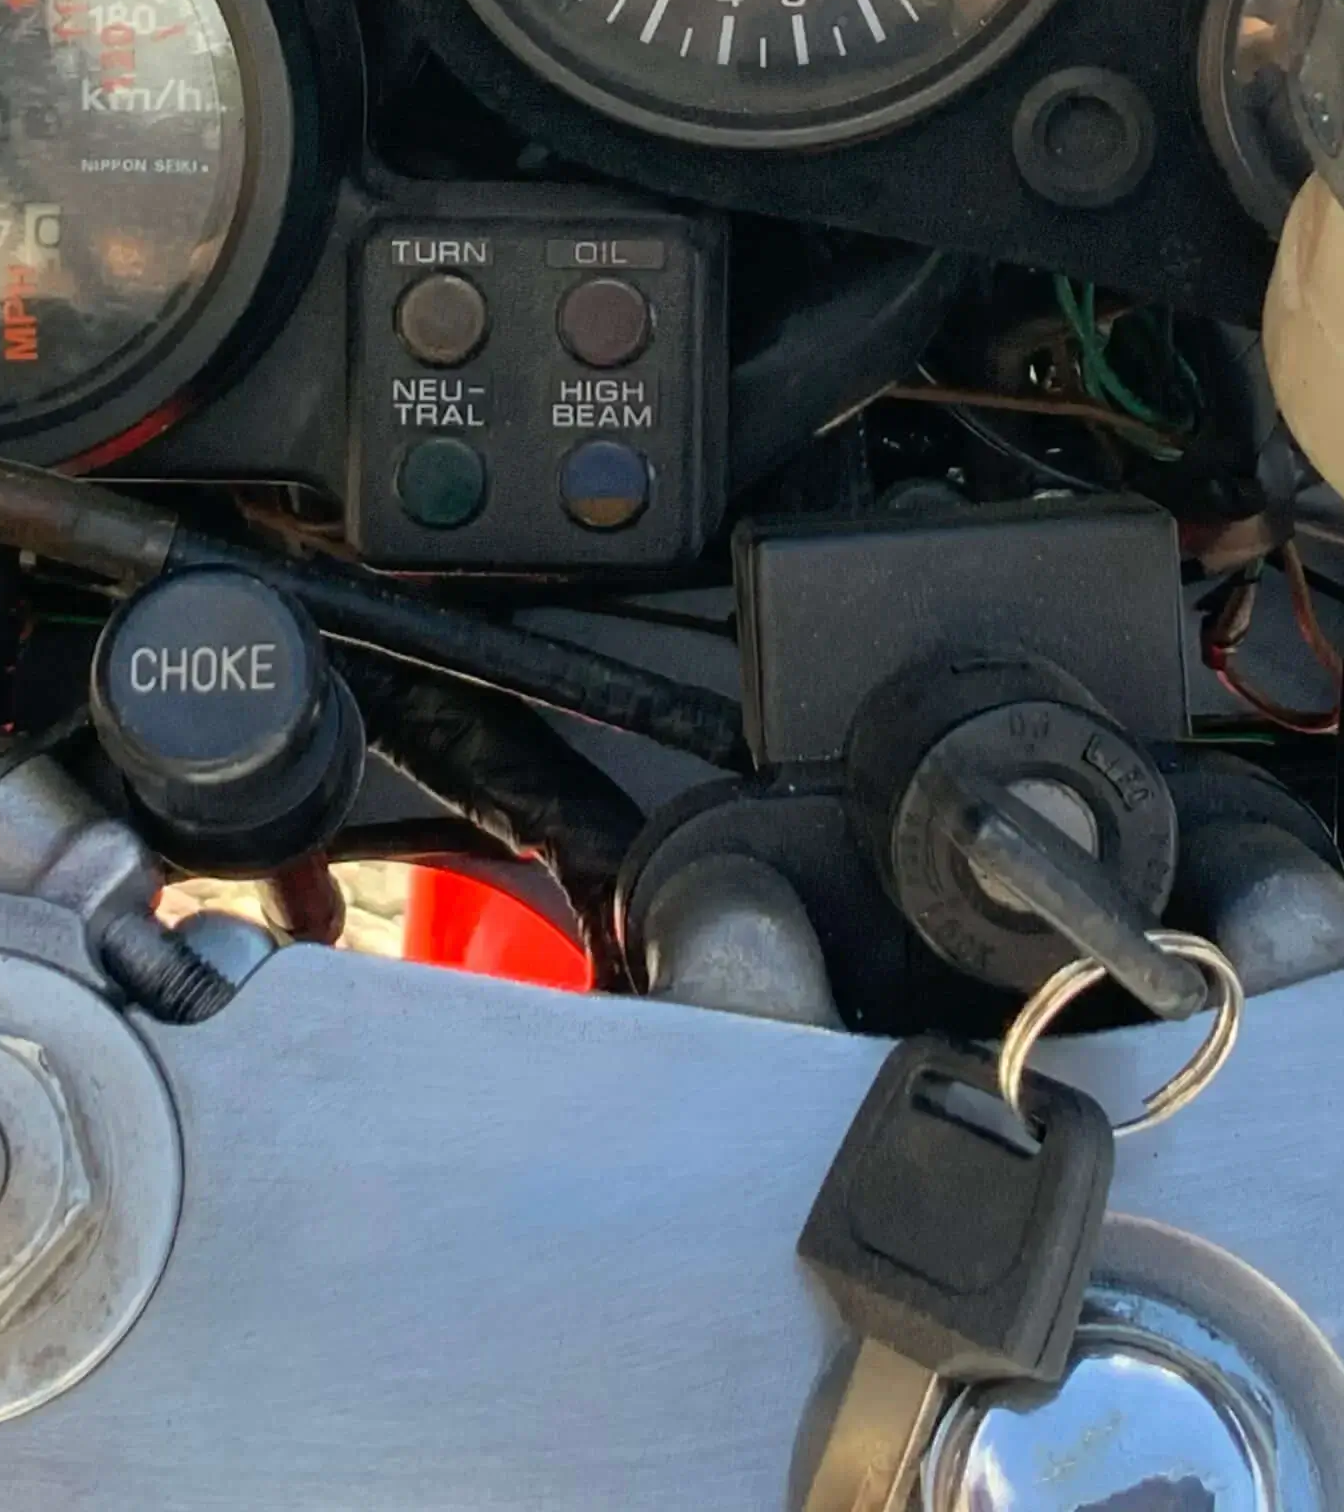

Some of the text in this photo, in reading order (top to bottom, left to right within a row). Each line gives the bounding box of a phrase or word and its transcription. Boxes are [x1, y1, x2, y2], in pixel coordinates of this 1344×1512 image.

[82, 79, 202, 112] km/h
[81, 158, 198, 174] NIPPON SEIKI
[391, 240, 487, 264] TURN
[574, 242, 629, 264] OIL
[3, 264, 39, 361] MPH
[393, 378, 486, 401] NEU-
[560, 380, 644, 403] HIGH
[393, 404, 485, 426] TRAL
[552, 406, 652, 427] BEAM
[130, 643, 277, 694] CHOKE
